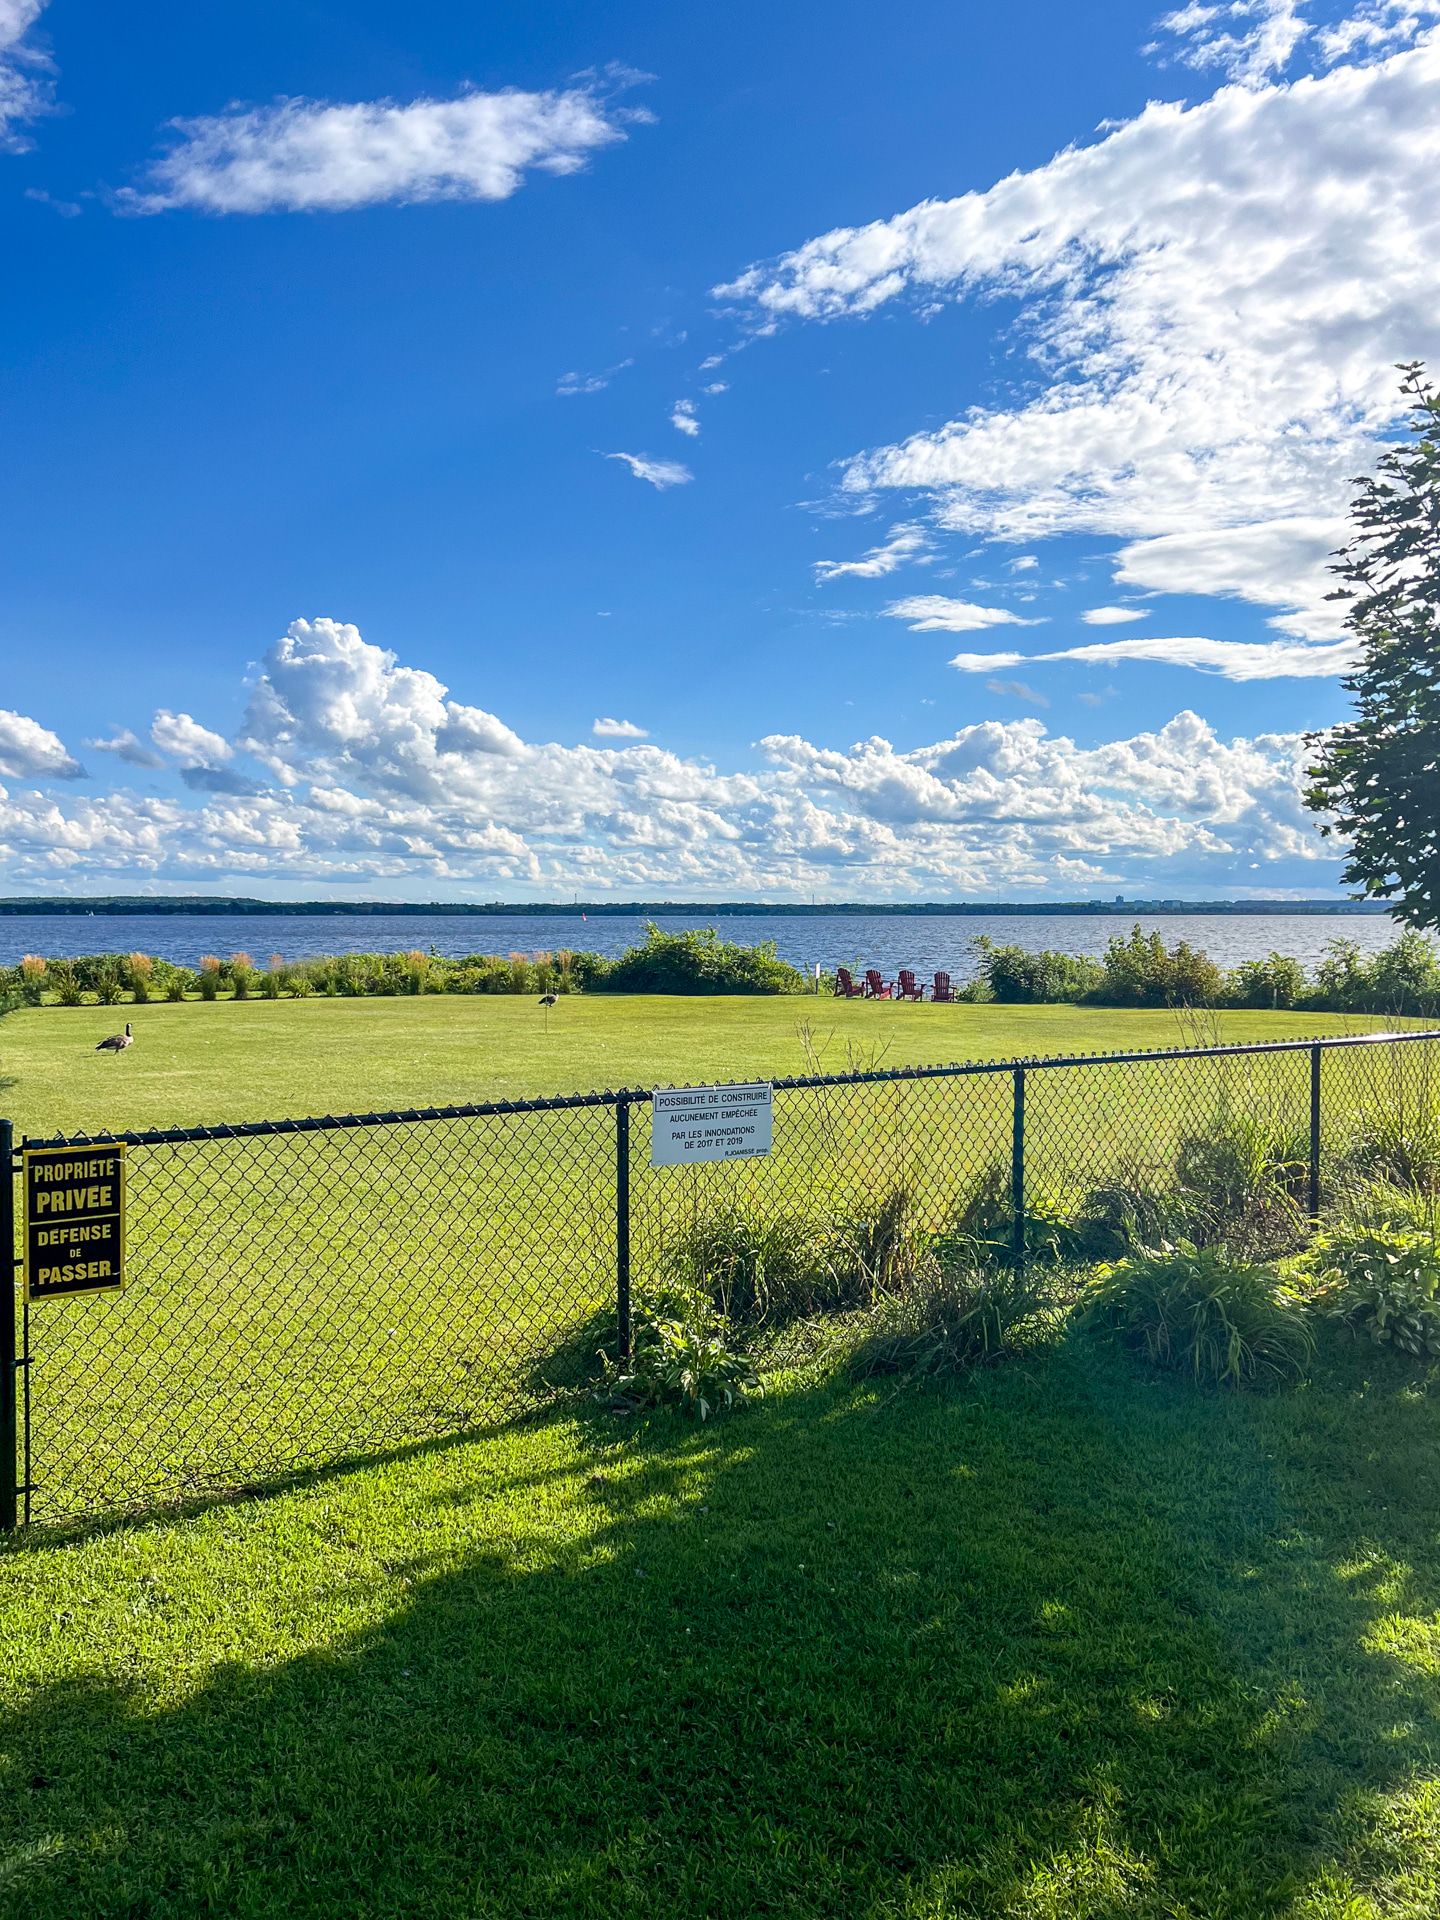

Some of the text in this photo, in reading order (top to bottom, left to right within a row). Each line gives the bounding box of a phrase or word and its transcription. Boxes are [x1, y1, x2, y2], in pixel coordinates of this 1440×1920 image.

[659, 1091, 768, 1107] POSSIBILITÉ DE CONSTRUIRE
[669, 1108, 758, 1123] AUCUNEMENT EMPÊCHÉE
[671, 1126, 755, 1140] PAR LES INNONDATIONS
[684, 1136, 743, 1149] DE 2017 ET 2019
[69, 1248, 82, 1258] DE
[38, 1260, 112, 1285] PASSER
